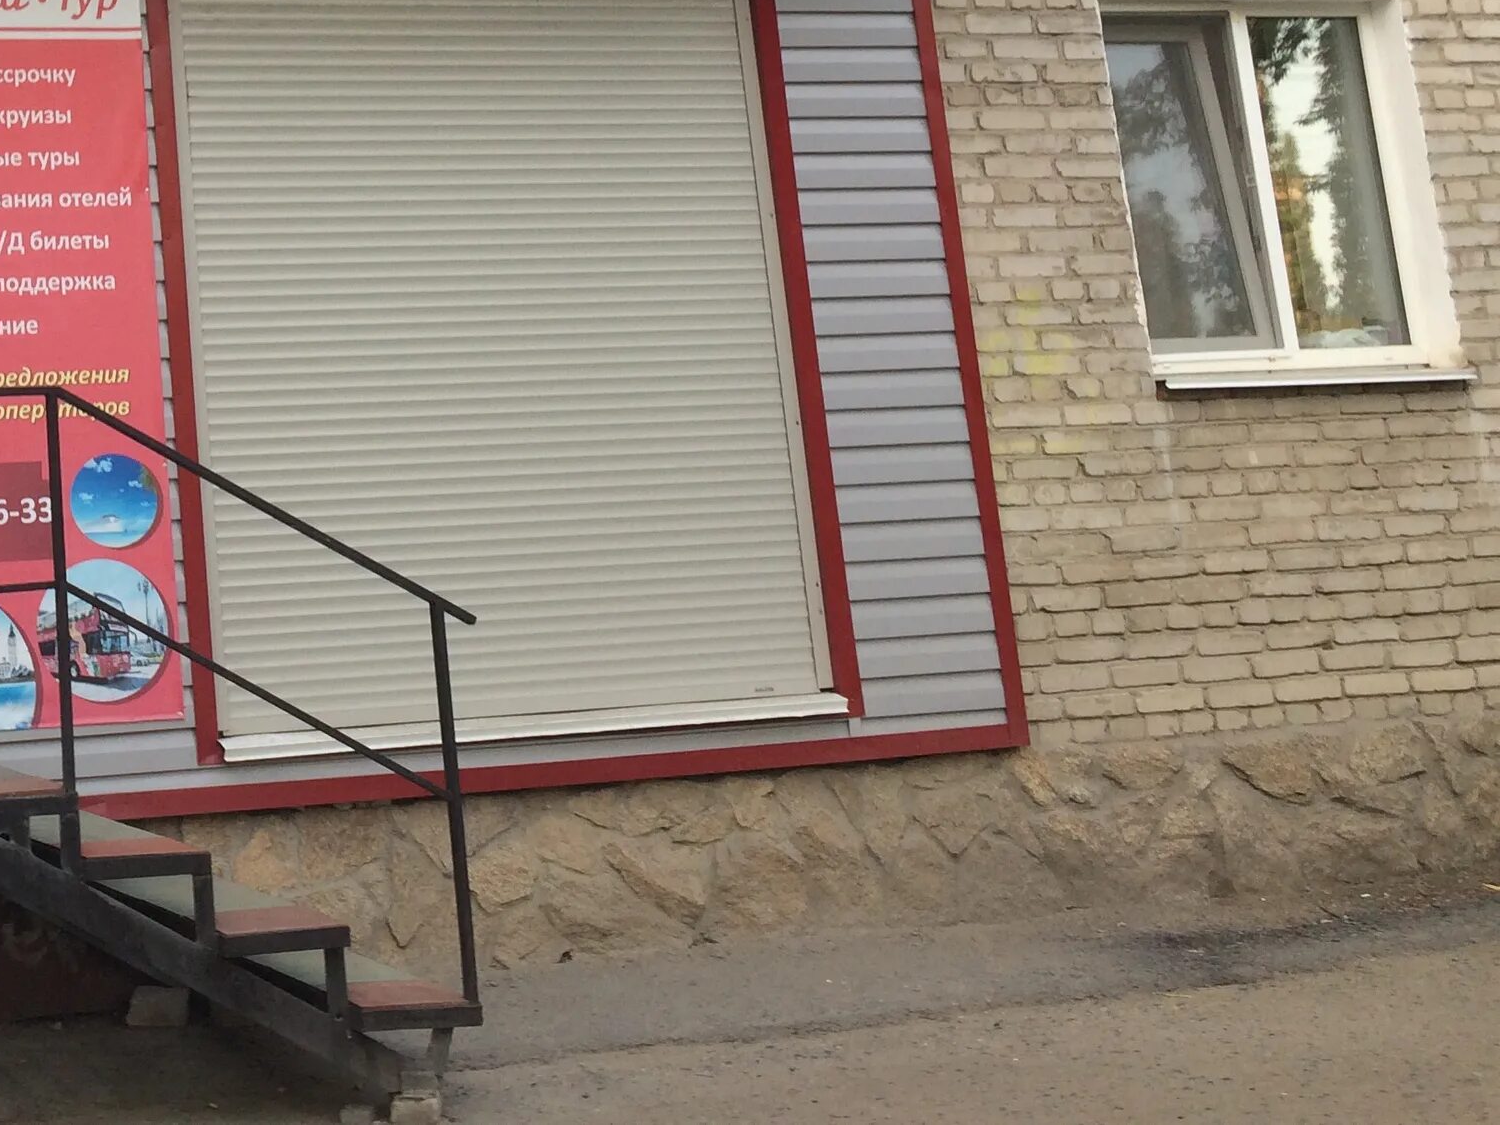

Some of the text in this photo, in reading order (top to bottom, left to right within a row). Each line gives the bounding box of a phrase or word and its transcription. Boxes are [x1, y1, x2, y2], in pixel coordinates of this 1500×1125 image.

[28, 150, 80, 171] туры
[59, 186, 132, 207] отелей
[30, 230, 110, 251] билеты
